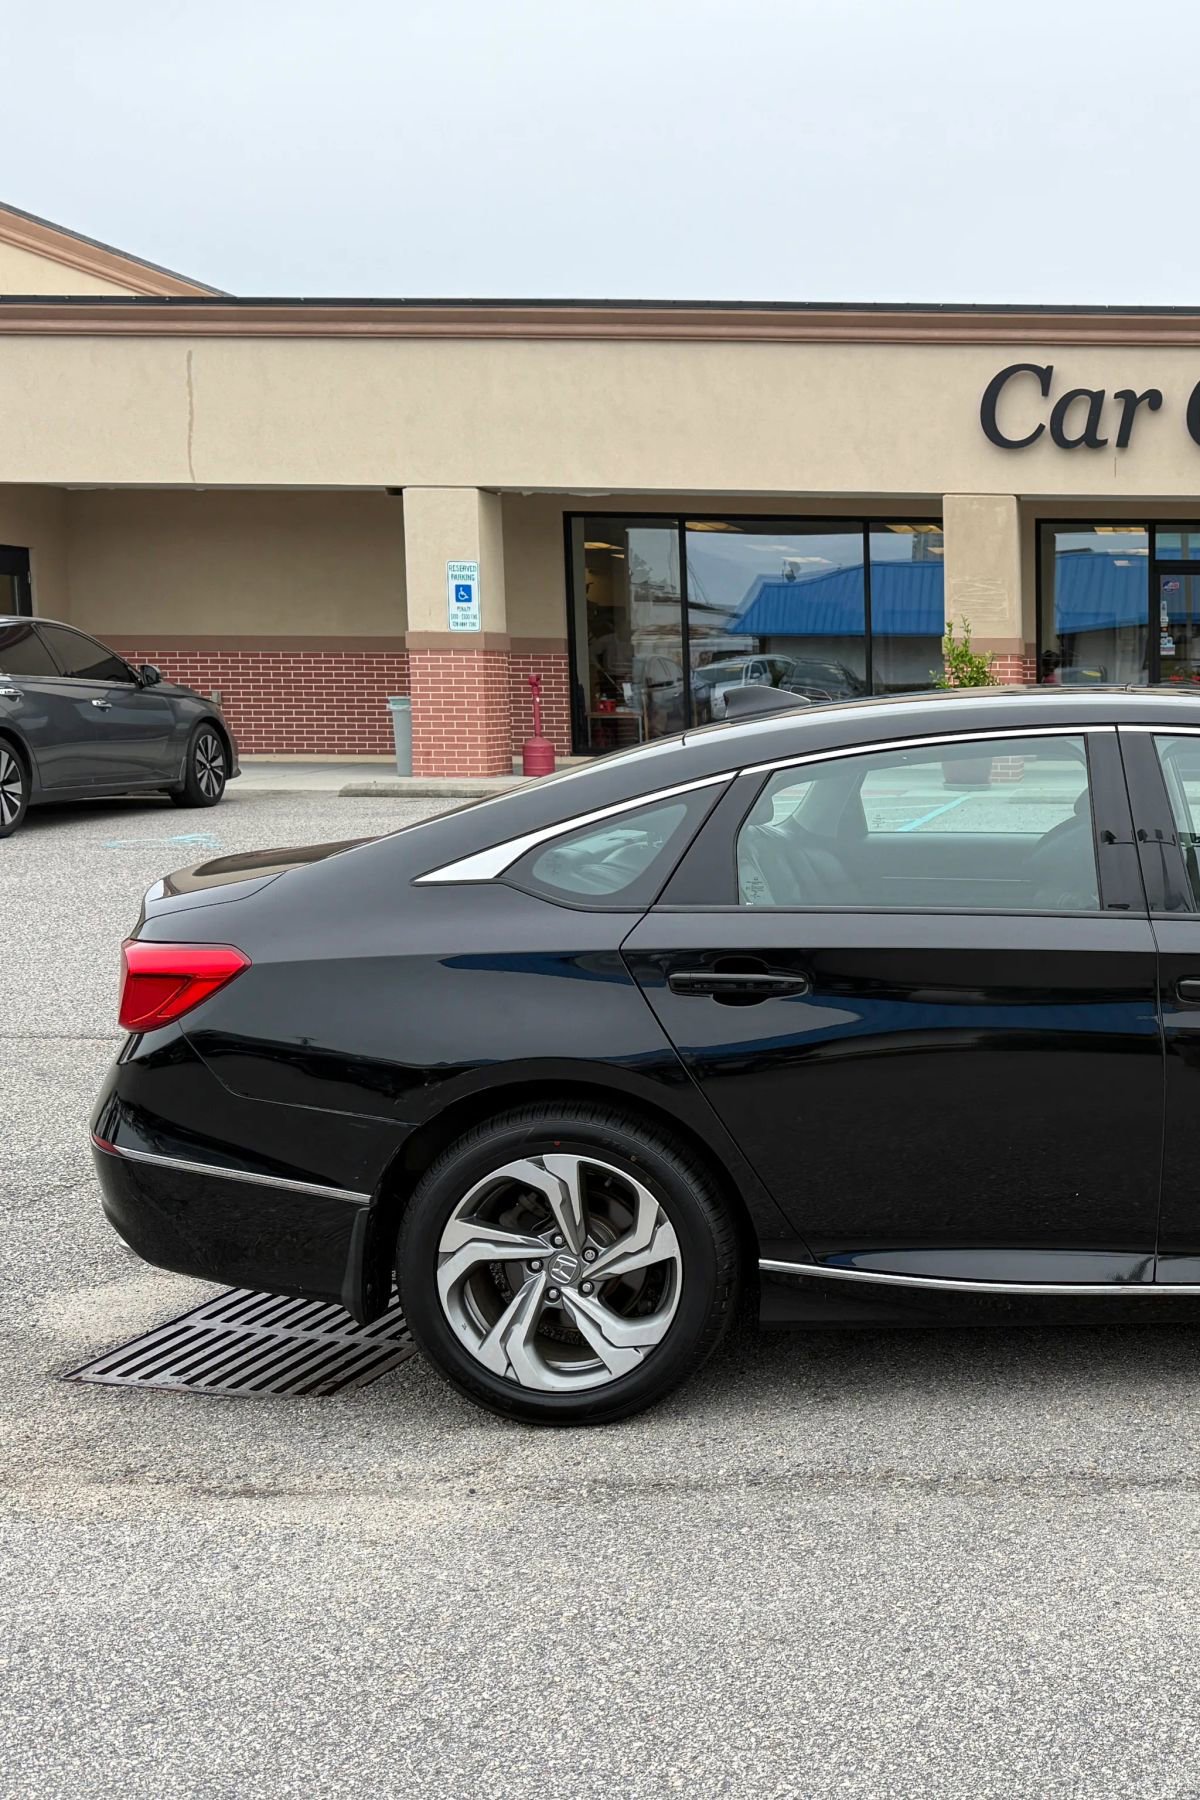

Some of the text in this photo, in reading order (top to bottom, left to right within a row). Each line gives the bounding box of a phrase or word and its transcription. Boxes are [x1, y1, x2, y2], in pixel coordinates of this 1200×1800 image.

[979, 363, 1163, 450] Car
[448, 564, 477, 572] RESERVED
[451, 573, 475, 581] PARKING
